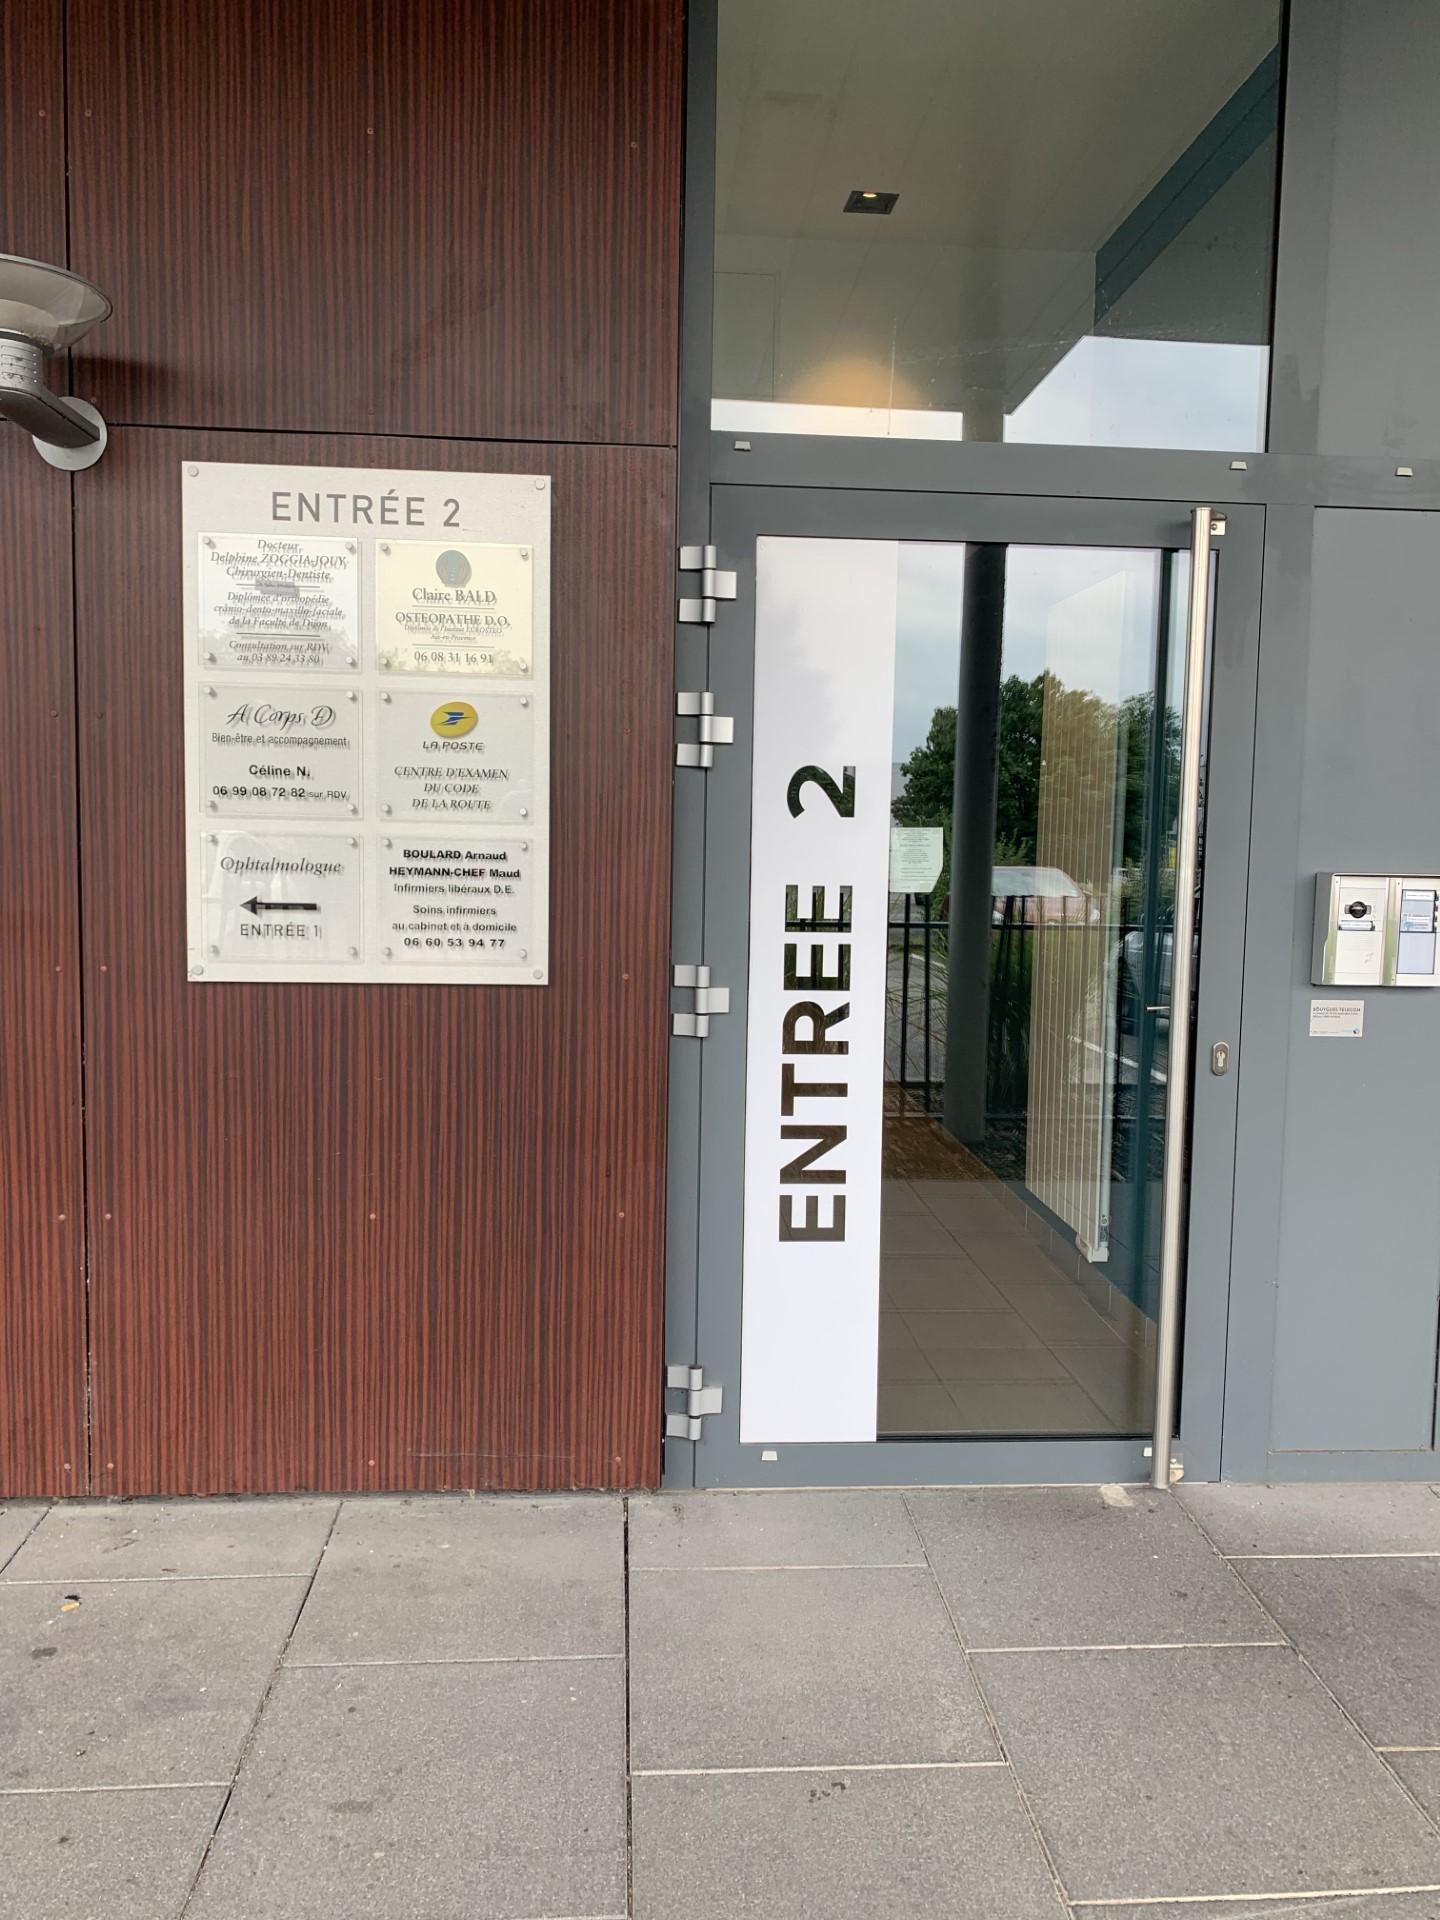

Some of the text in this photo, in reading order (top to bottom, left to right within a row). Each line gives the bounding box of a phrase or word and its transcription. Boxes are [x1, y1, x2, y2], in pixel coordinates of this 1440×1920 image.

[272, 488, 460, 527] ENTRÉE 2
[257, 539, 300, 550] Docteur
[210, 551, 347, 566] Delphine ZOGGIA-JOUY
[226, 566, 331, 579] Chirurgien-Dentiste
[412, 588, 496, 603] Claire BALD
[228, 616, 241, 625] de
[242, 617, 251, 625] la
[253, 617, 287, 626] Faculté
[288, 618, 300, 627] de
[395, 612, 511, 626] OSTEOPATHE D.O.
[228, 640, 287, 650] Consultation
[306, 643, 329, 652] RDV
[251, 653, 263, 662] 03
[266, 653, 278, 663] 89
[279, 654, 292, 663] 24
[414, 651, 493, 663] 06 08 31 16 91
[225, 703, 249, 725] A
[254, 703, 304, 731] Corps
[212, 732, 347, 747] Bien-être et accompagnement
[422, 741, 484, 751] LA POSTE
[249, 764, 311, 777] Céline N.
[394, 766, 508, 779] CENTRE D'EXAMEN
[212, 786, 228, 796] 06
[232, 786, 247, 796] 99
[252, 787, 267, 797] 08
[272, 787, 286, 797] 72
[291, 788, 305, 798] 82
[327, 791, 347, 799] RDV
[424, 783, 479, 793] DU CODE
[411, 798, 491, 809] DE LA ROUTE
[403, 849, 507, 861] BOULARD Arnaud
[220, 856, 342, 876] Ophtalmologue
[389, 866, 520, 878] HEYMANN-CHEF Maud
[394, 883, 514, 894] Infirmiers libéraux D.E.
[413, 904, 496, 915] Soins infirmiers
[240, 921, 319, 937] ENTRÉE 1
[408, 921, 447, 930] cabinet
[450, 923, 460, 931] et
[463, 922, 469, 931] à
[472, 922, 517, 932] domicile
[404, 937, 505, 947] 06 60 53 94 77
[779, 765, 856, 1242] ENTREE 2
